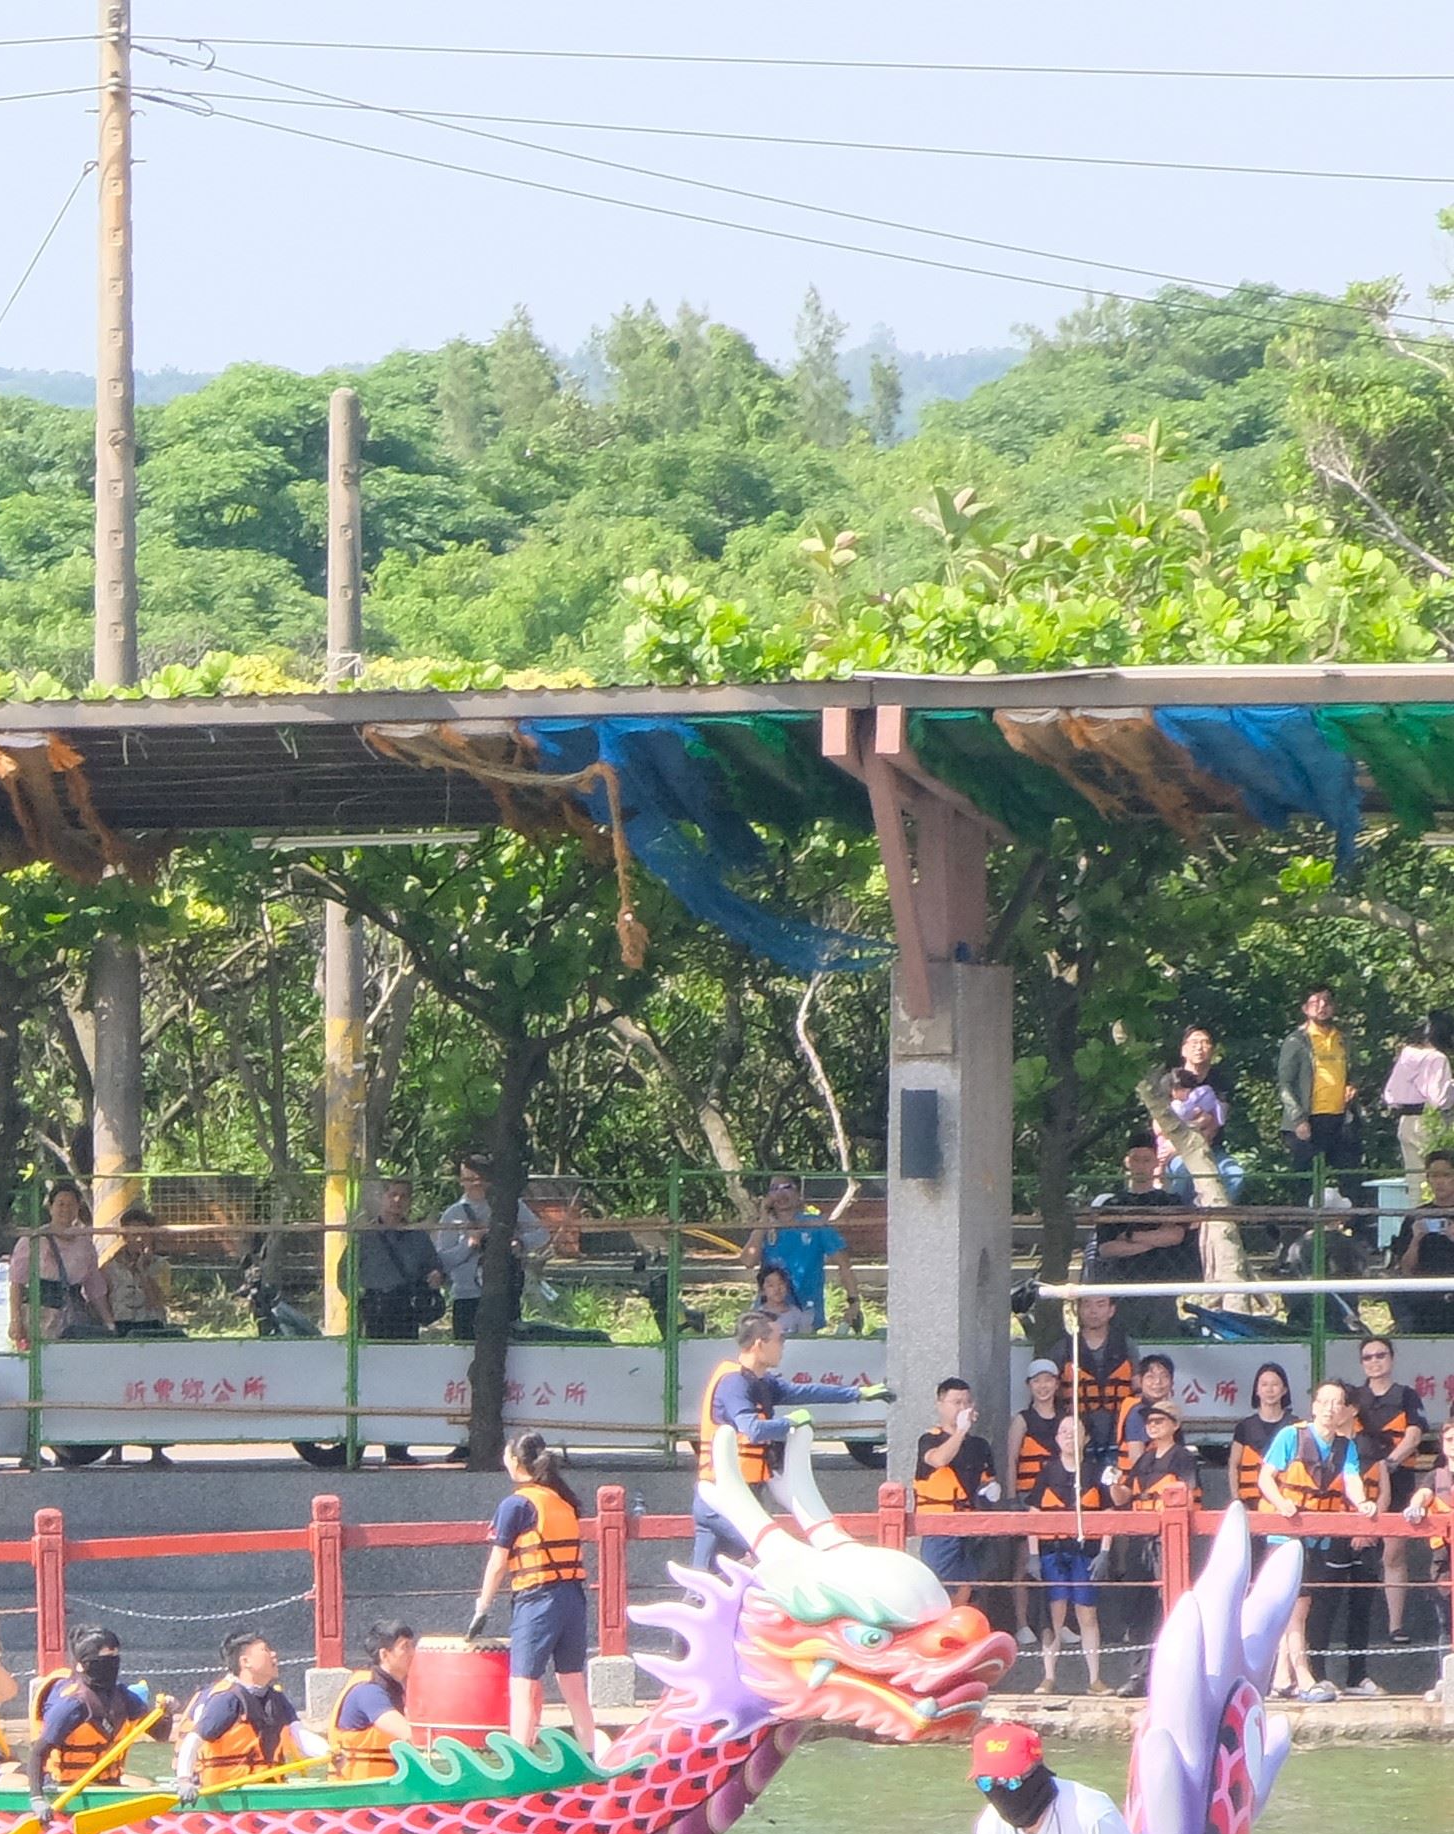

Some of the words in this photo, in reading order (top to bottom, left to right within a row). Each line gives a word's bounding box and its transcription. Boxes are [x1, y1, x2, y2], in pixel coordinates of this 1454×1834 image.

[444, 1380, 587, 1406] 新鄉公所
[1170, 1378, 1238, 1406] 公所
